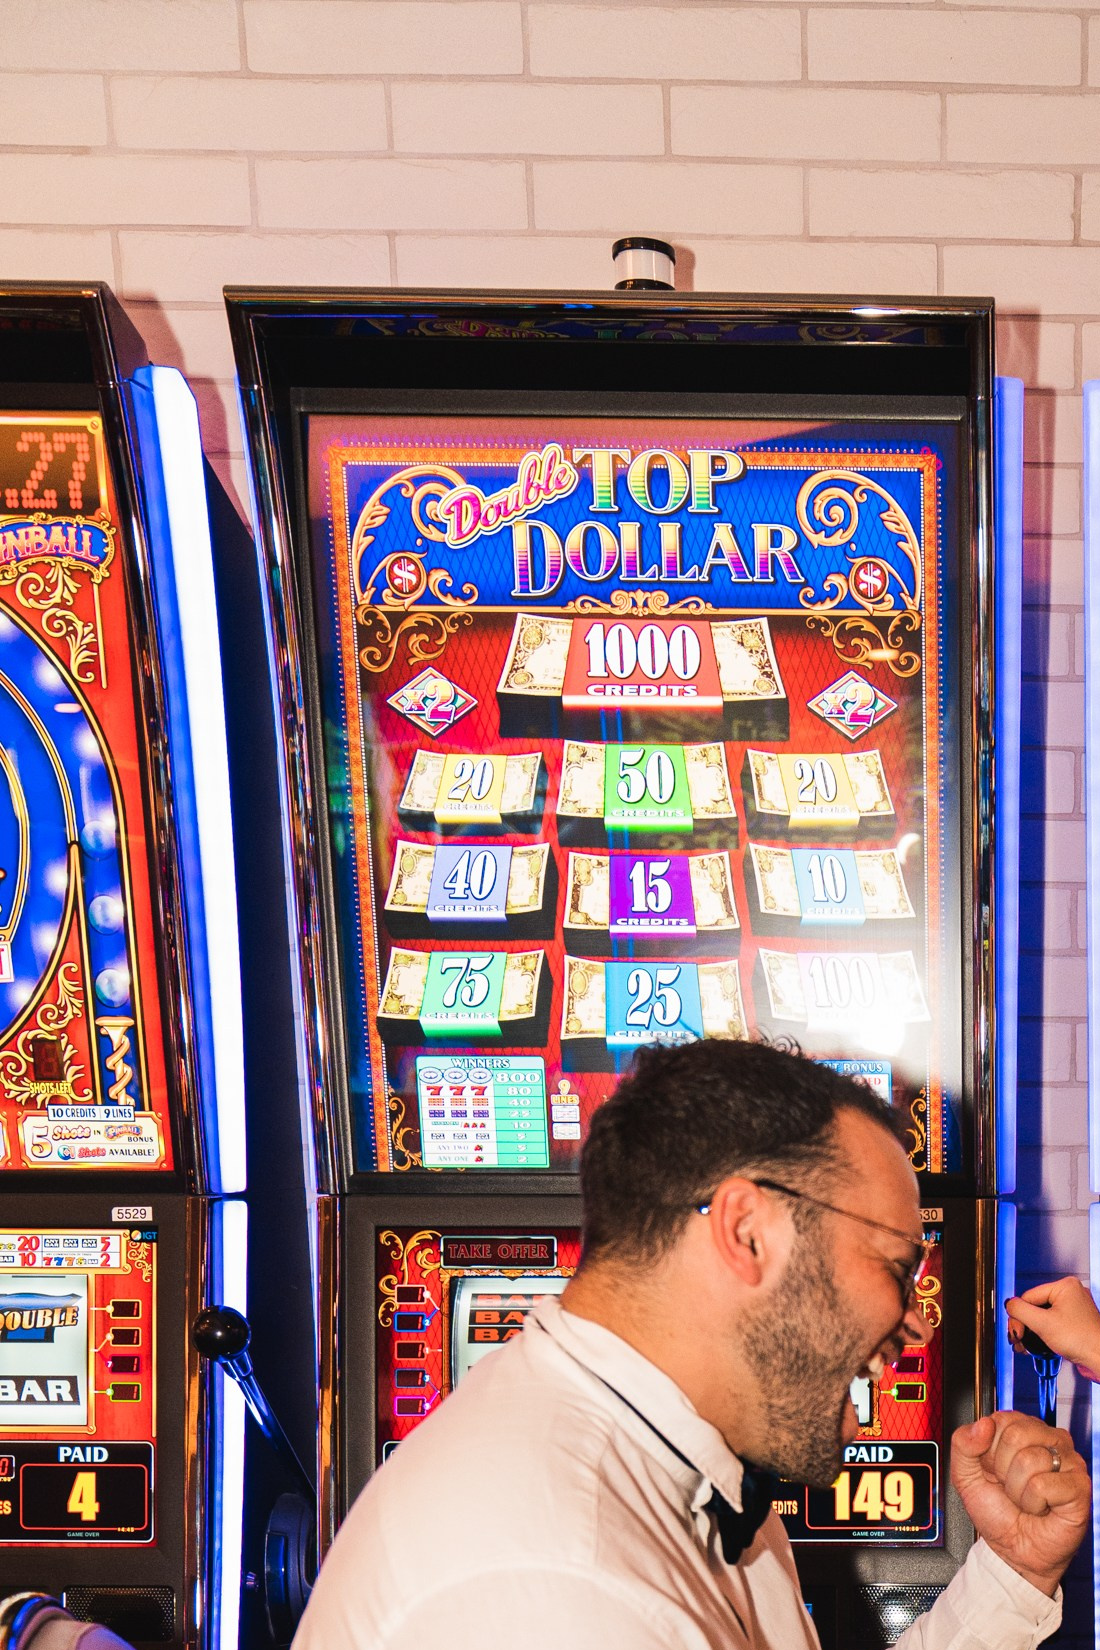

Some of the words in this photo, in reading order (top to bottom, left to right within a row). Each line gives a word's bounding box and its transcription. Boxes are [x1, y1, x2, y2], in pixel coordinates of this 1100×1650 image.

[0, 432, 90, 509] .27
[572, 448, 744, 513] TOP
[441, 446, 578, 547] Double
[511, 521, 804, 597] DOLLAR
[584, 621, 702, 680] 1000
[586, 683, 699, 697] CREDITS
[447, 758, 496, 801] 20
[618, 748, 676, 806] 50
[793, 758, 838, 803] 20
[611, 808, 686, 819] CREDITS
[443, 849, 499, 901] 40
[809, 854, 848, 902] 10
[628, 858, 673, 914] 15
[433, 904, 499, 914] CREDITS
[616, 916, 689, 927] CREDITS
[440, 953, 494, 1008] 75
[809, 951, 876, 1009] 100
[626, 965, 683, 1030] 25
[425, 1010, 497, 1020] CREDITS
[451, 1058, 511, 1069] WINNERS
[843, 1063, 883, 1072] BONUS
[495, 1072, 541, 1083] 800
[30, 1083, 54, 1094] SHOTS
[55, 1083, 72, 1094] LEFT
[507, 1086, 531, 1096] 80
[557, 1080, 571, 1095] 9
[508, 1097, 532, 1106] 40
[552, 1096, 578, 1104] LINES
[52, 1108, 64, 1118] 10
[65, 1108, 97, 1118] CREDITS
[104, 1110, 110, 1118] 9
[111, 1109, 132, 1118] LINES
[31, 1125, 53, 1158] 5
[52, 1125, 91, 1141] Shots
[107, 1125, 141, 1139] PINBALL
[77, 1147, 106, 1159] Shots
[109, 1148, 155, 1157] AVAILABLE!
[117, 1208, 147, 1220] 5529
[142, 1231, 157, 1240] IGT
[17, 1236, 40, 1251] 20
[101, 1237, 111, 1252] 5
[448, 1244, 493, 1259] TAKE
[498, 1244, 549, 1259] OFFER
[18, 1253, 36, 1266] 10
[100, 1253, 111, 1267] 2
[0, 1380, 73, 1404] BAR
[58, 1446, 109, 1462] PAID
[844, 1446, 893, 1463] PAID
[67, 1472, 99, 1521] 4
[832, 1471, 914, 1522] 149
[772, 1500, 798, 1515] EDITS
